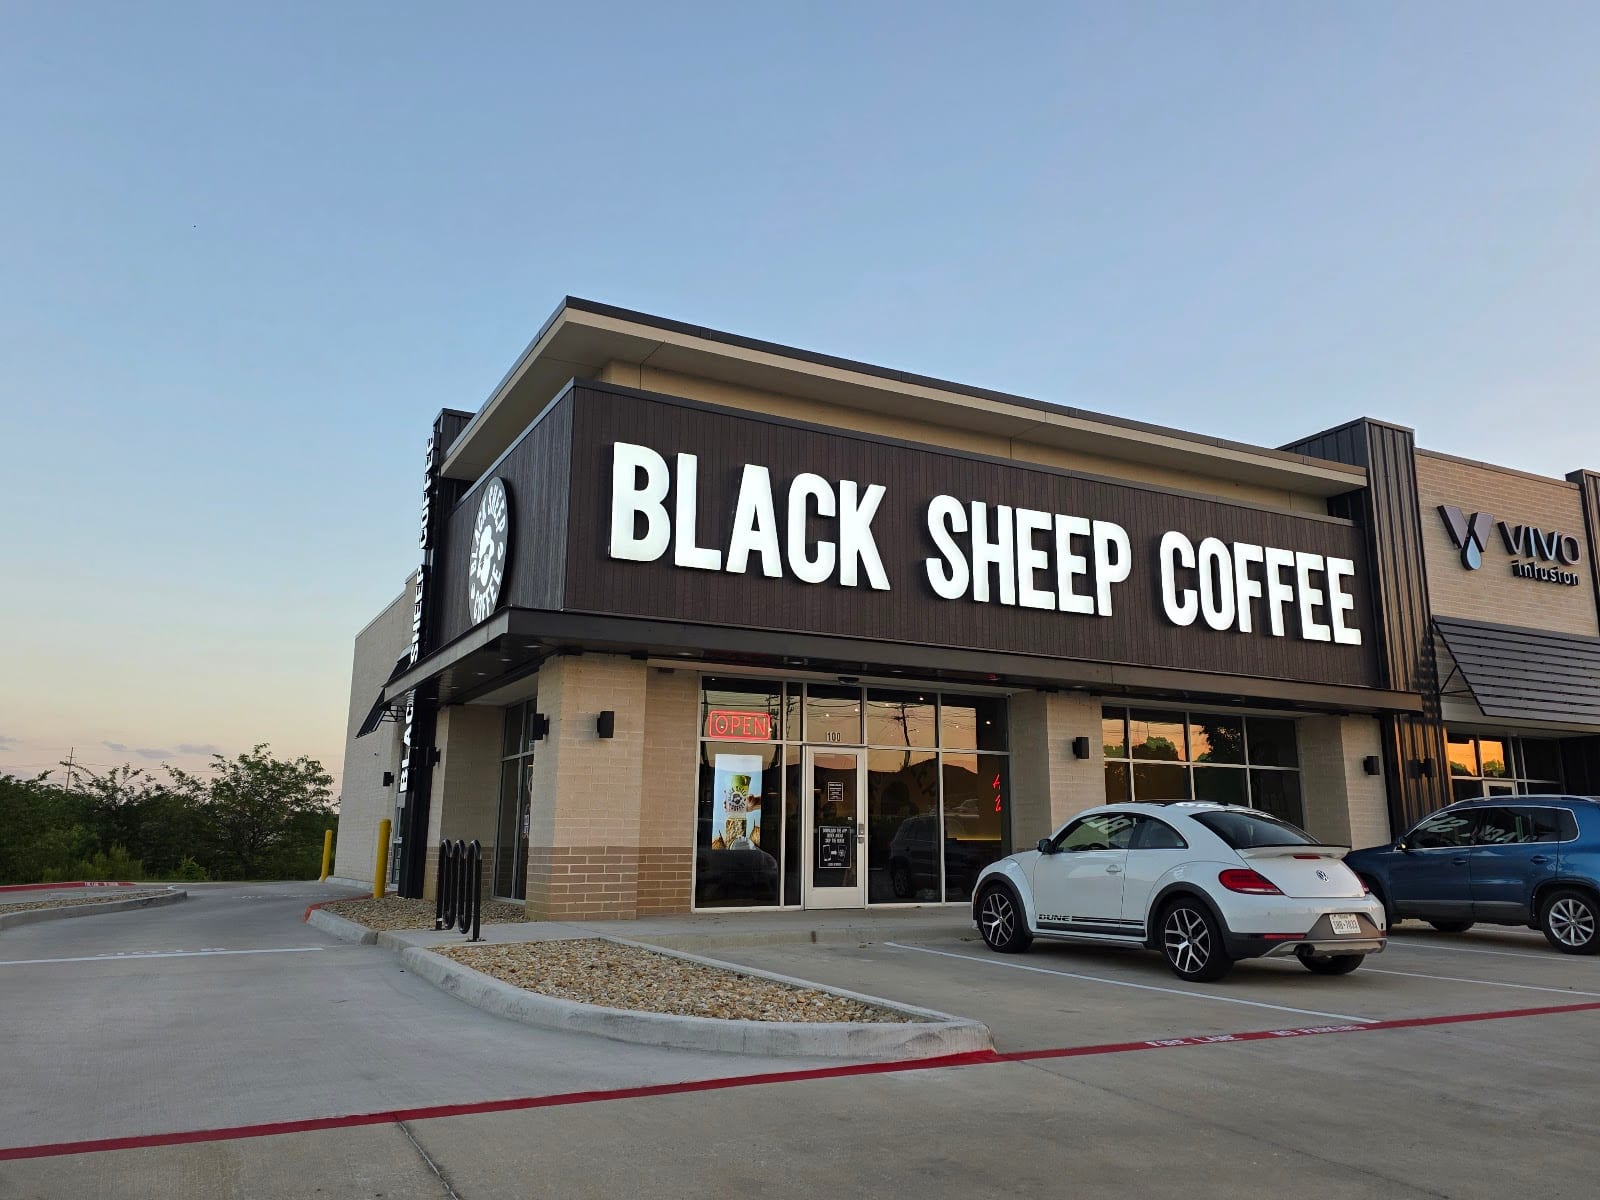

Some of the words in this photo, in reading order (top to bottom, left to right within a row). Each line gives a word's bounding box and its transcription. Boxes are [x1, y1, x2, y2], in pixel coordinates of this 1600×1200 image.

[469, 496, 487, 577] BLACK
[487, 484, 505, 533] SHEEP
[610, 441, 891, 591] BLACK
[926, 494, 1132, 617] SHEEP
[1160, 530, 1363, 646] COFFEE
[1497, 521, 1582, 566] VIVO
[1511, 560, 1581, 586] infusion
[714, 715, 767, 736] OPEN
[827, 731, 842, 742] 100
[1038, 913, 1071, 922] DUNE
